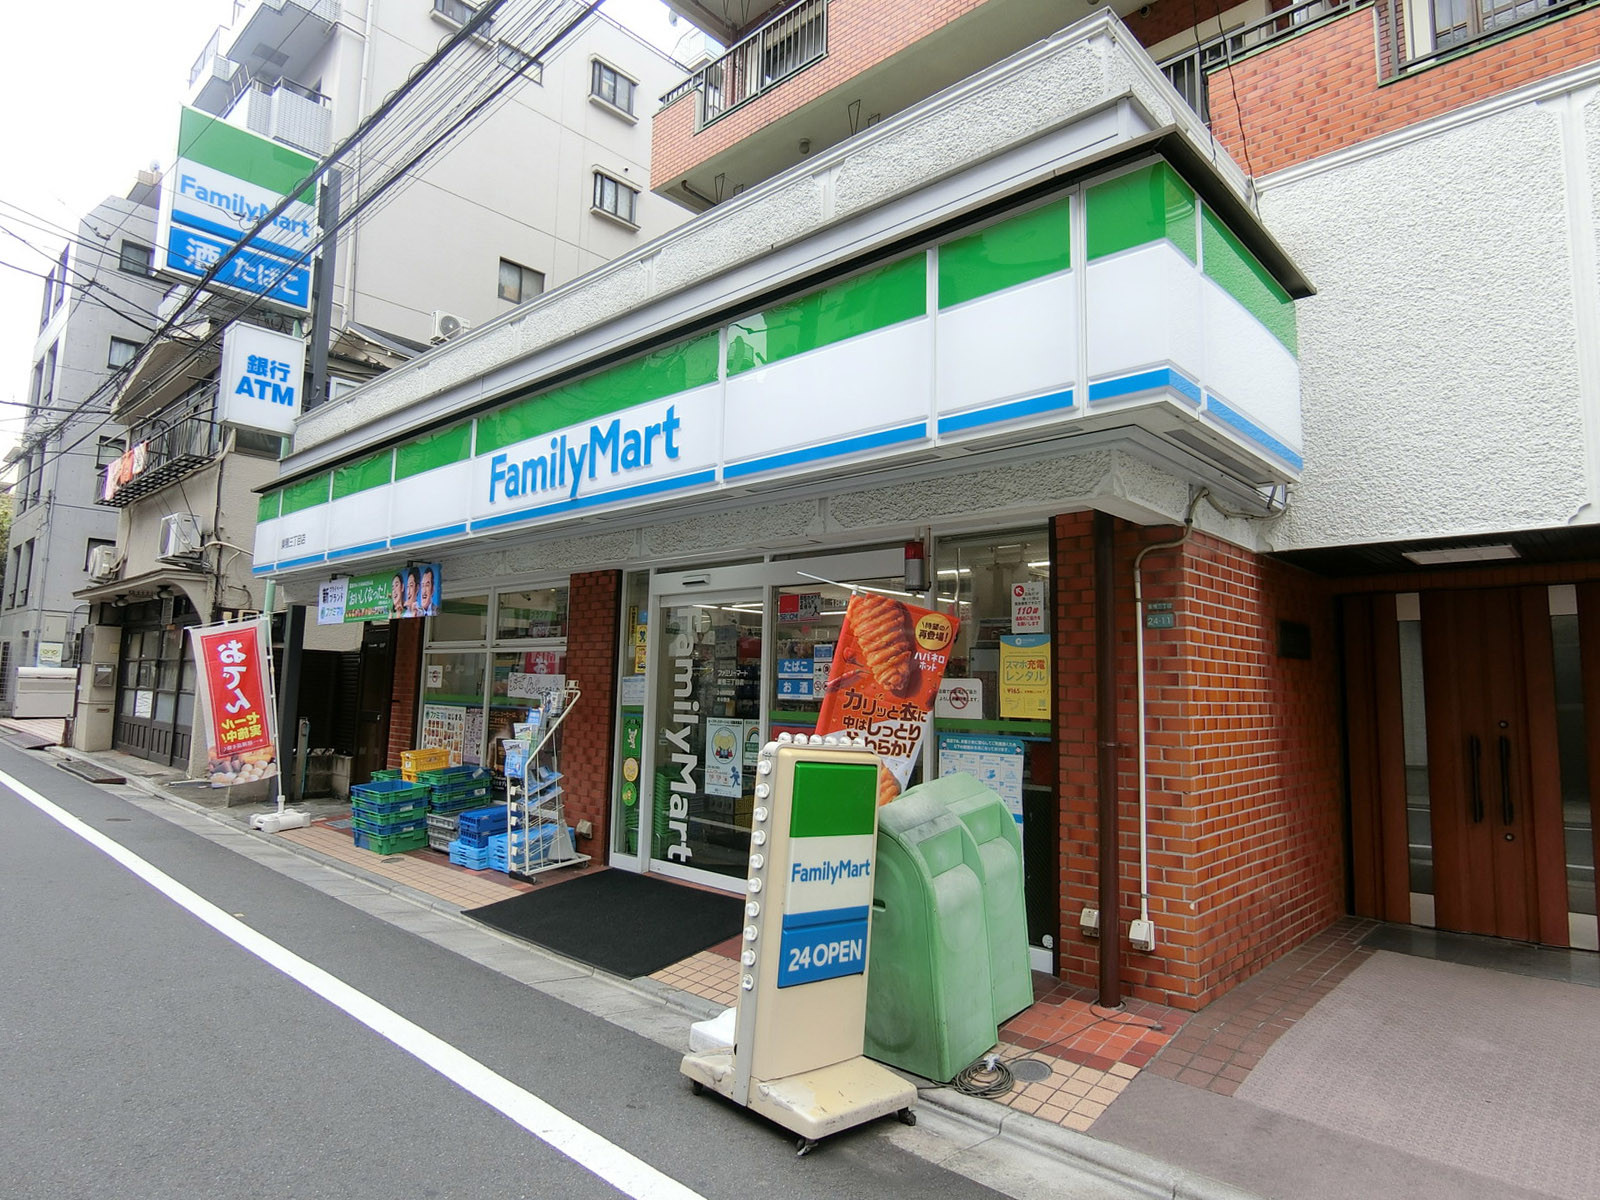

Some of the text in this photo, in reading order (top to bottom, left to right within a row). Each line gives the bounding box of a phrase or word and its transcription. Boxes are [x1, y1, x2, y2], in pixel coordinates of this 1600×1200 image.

[184, 237, 299, 296] 酒 たばこ
[247, 354, 291, 381] 銀行
[235, 378, 295, 406] ATM
[488, 404, 681, 503] FamilyMart
[783, 661, 808, 672] たばこ
[919, 661, 937, 672] ホット
[1005, 660, 1046, 670] スマホ充電
[1006, 671, 1045, 681] レンタル
[783, 681, 809, 693] お酒
[842, 688, 929, 723] カリッと衣に
[665, 606, 701, 863] FamilyMart
[843, 715, 922, 742] 中はしっとり
[791, 859, 871, 884] FamilyMart
[788, 939, 862, 971] 24 OPEN
